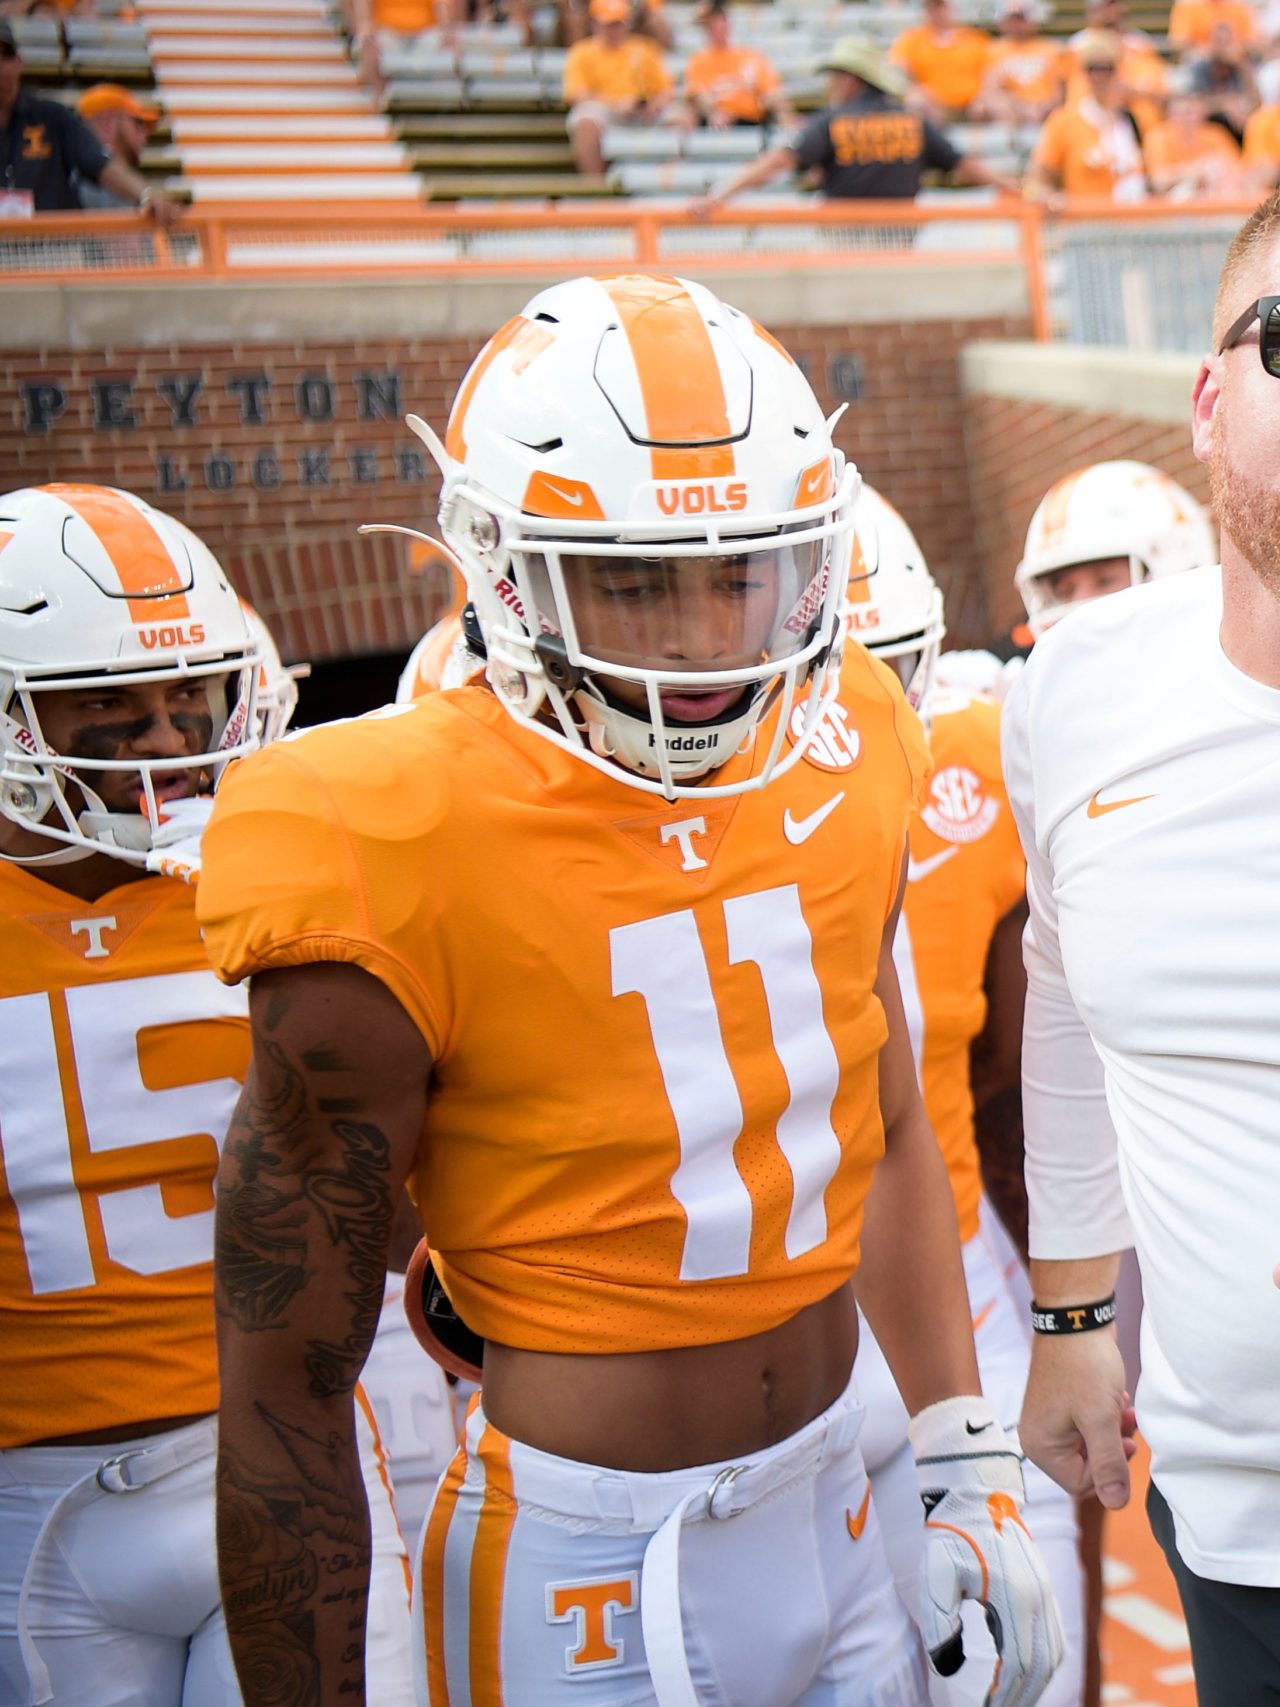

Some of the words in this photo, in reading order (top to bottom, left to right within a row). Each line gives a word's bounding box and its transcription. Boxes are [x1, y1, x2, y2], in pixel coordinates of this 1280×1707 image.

[20, 372, 402, 433] PEYTON
[157, 449, 428, 493] LOCKER
[656, 482, 748, 515] VOLS
[138, 624, 205, 650] VOLS
[847, 608, 879, 631] LS
[659, 817, 709, 871] T
[70, 915, 118, 958] T
[609, 884, 840, 1281] 11
[0, 969, 250, 1295] 15
[545, 1571, 638, 1674] T
